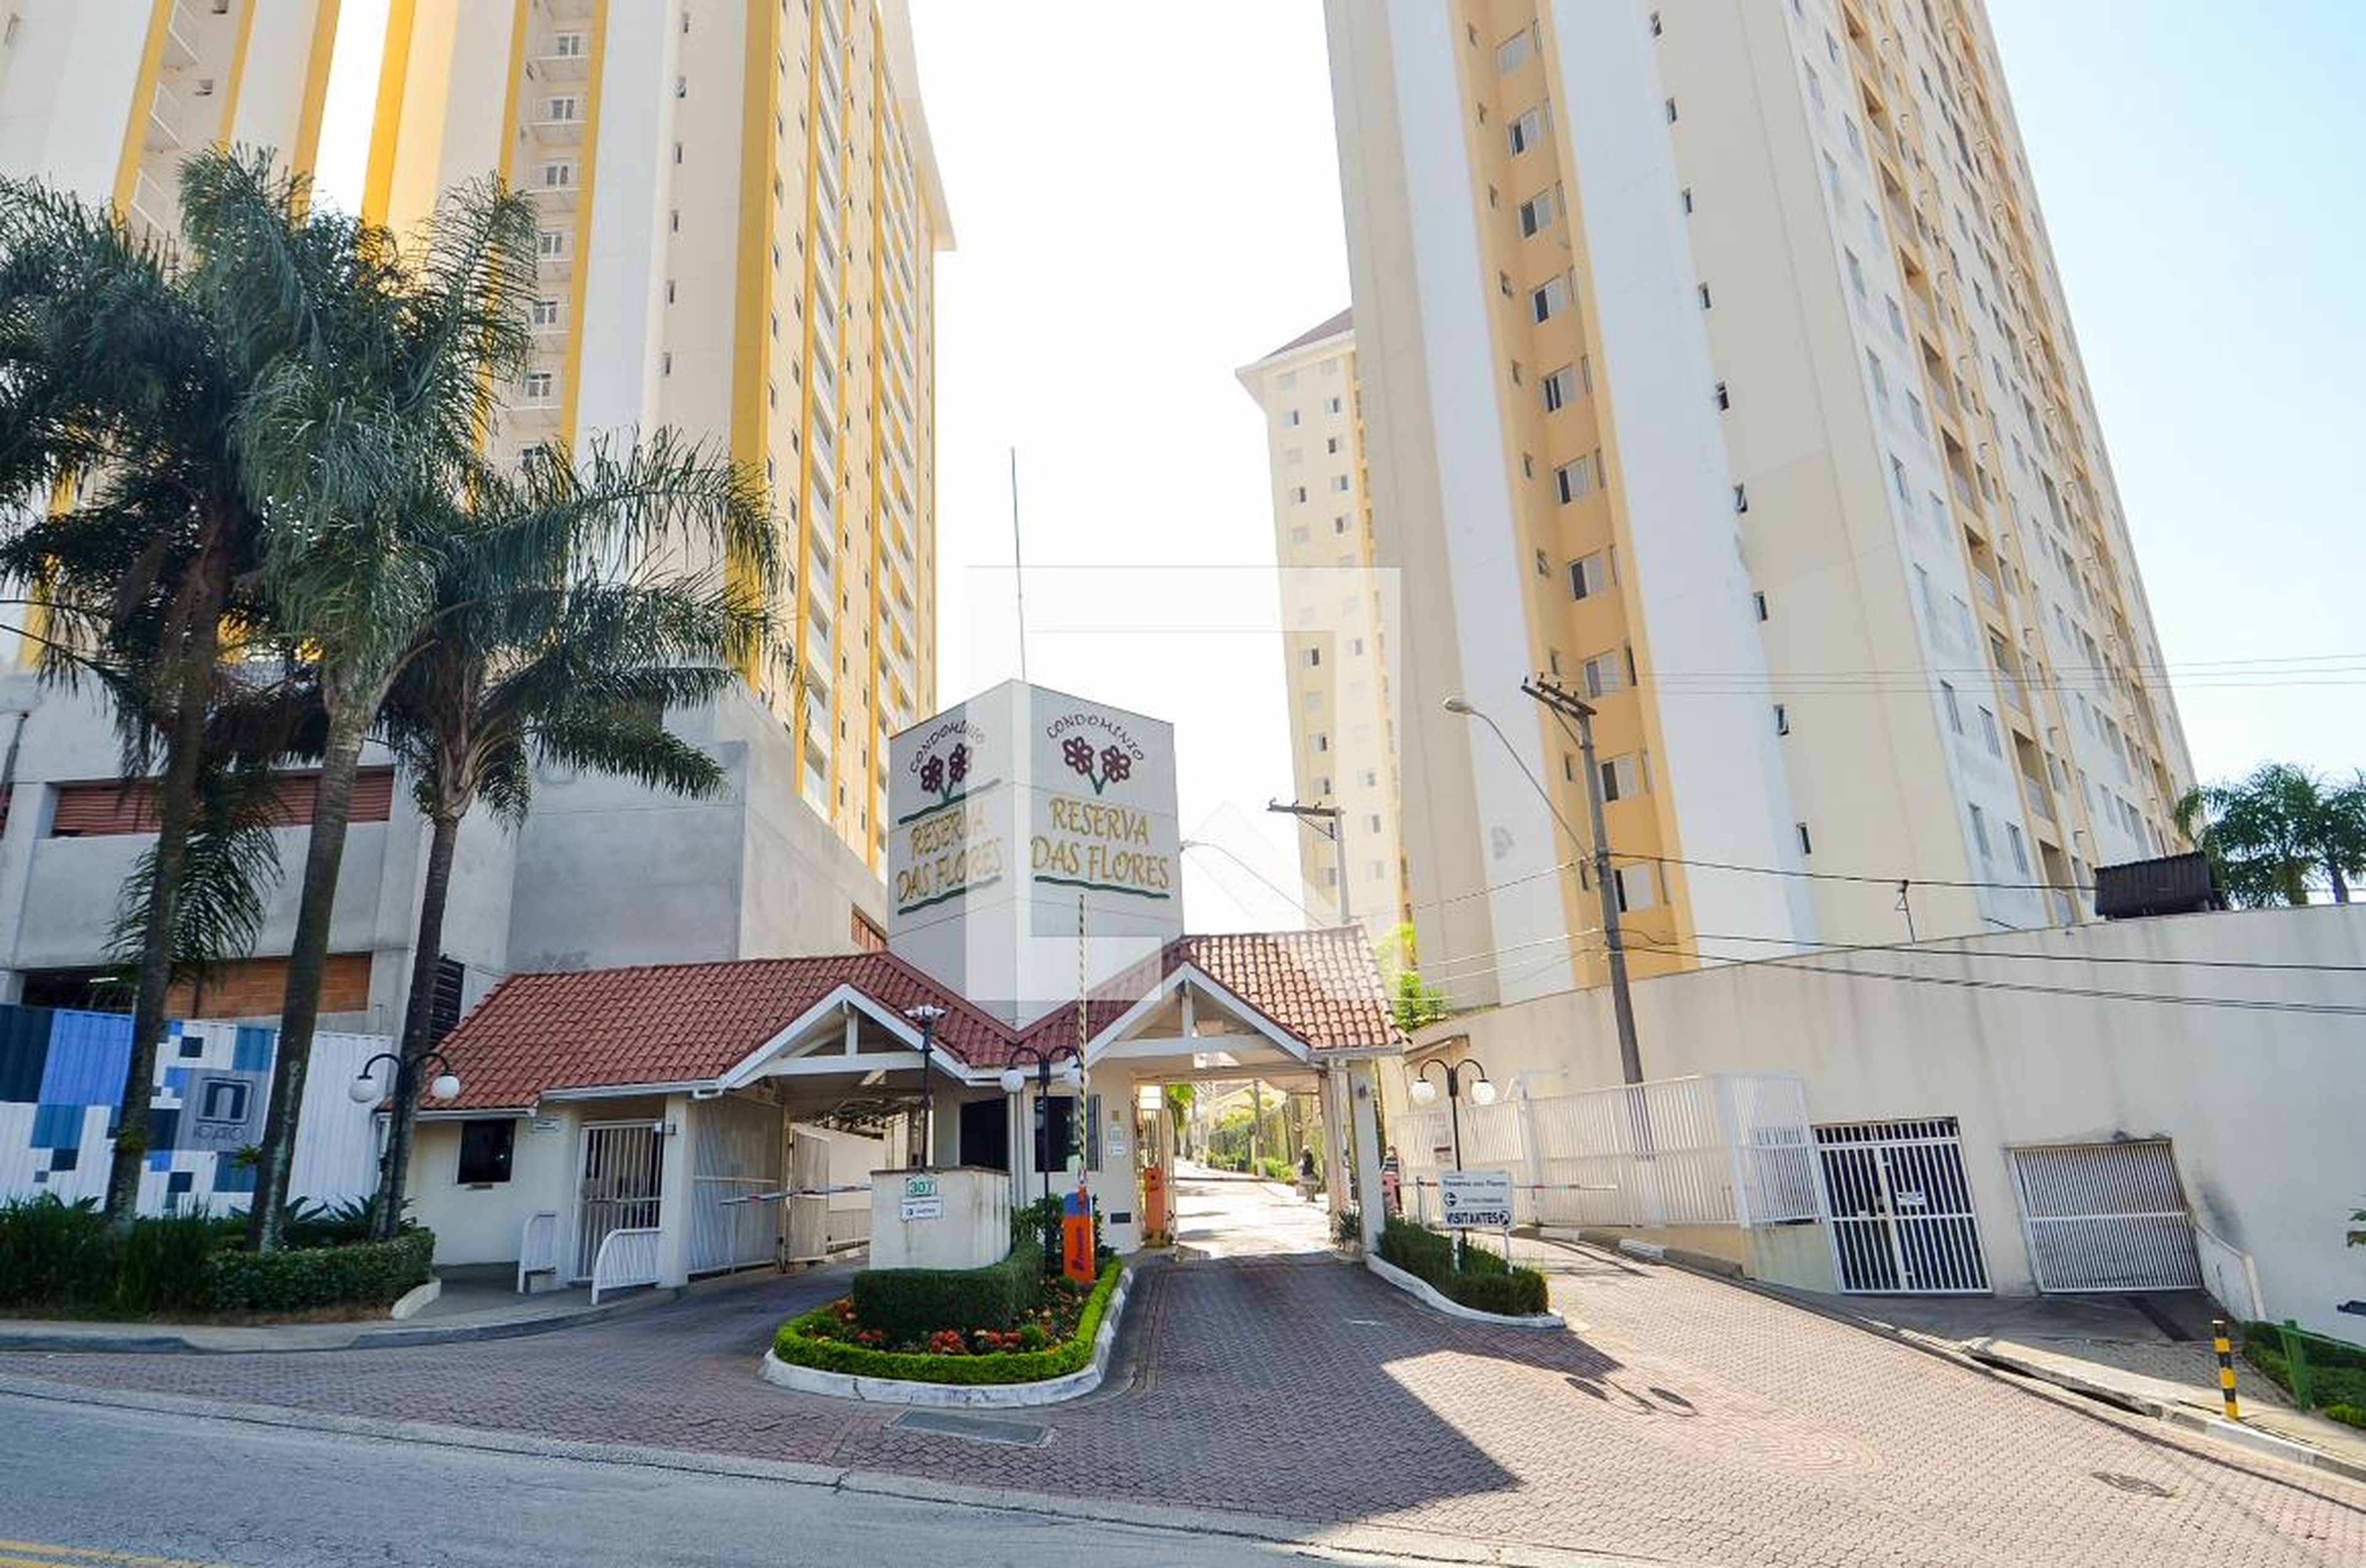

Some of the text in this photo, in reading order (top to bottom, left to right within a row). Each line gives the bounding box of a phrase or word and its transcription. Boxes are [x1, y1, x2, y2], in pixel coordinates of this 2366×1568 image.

[1049, 797, 1152, 845] RESERVA
[896, 837, 1004, 903] DAS FLORES
[1030, 835, 1169, 890] DAS FLORES
[909, 1180, 934, 1193] 307
